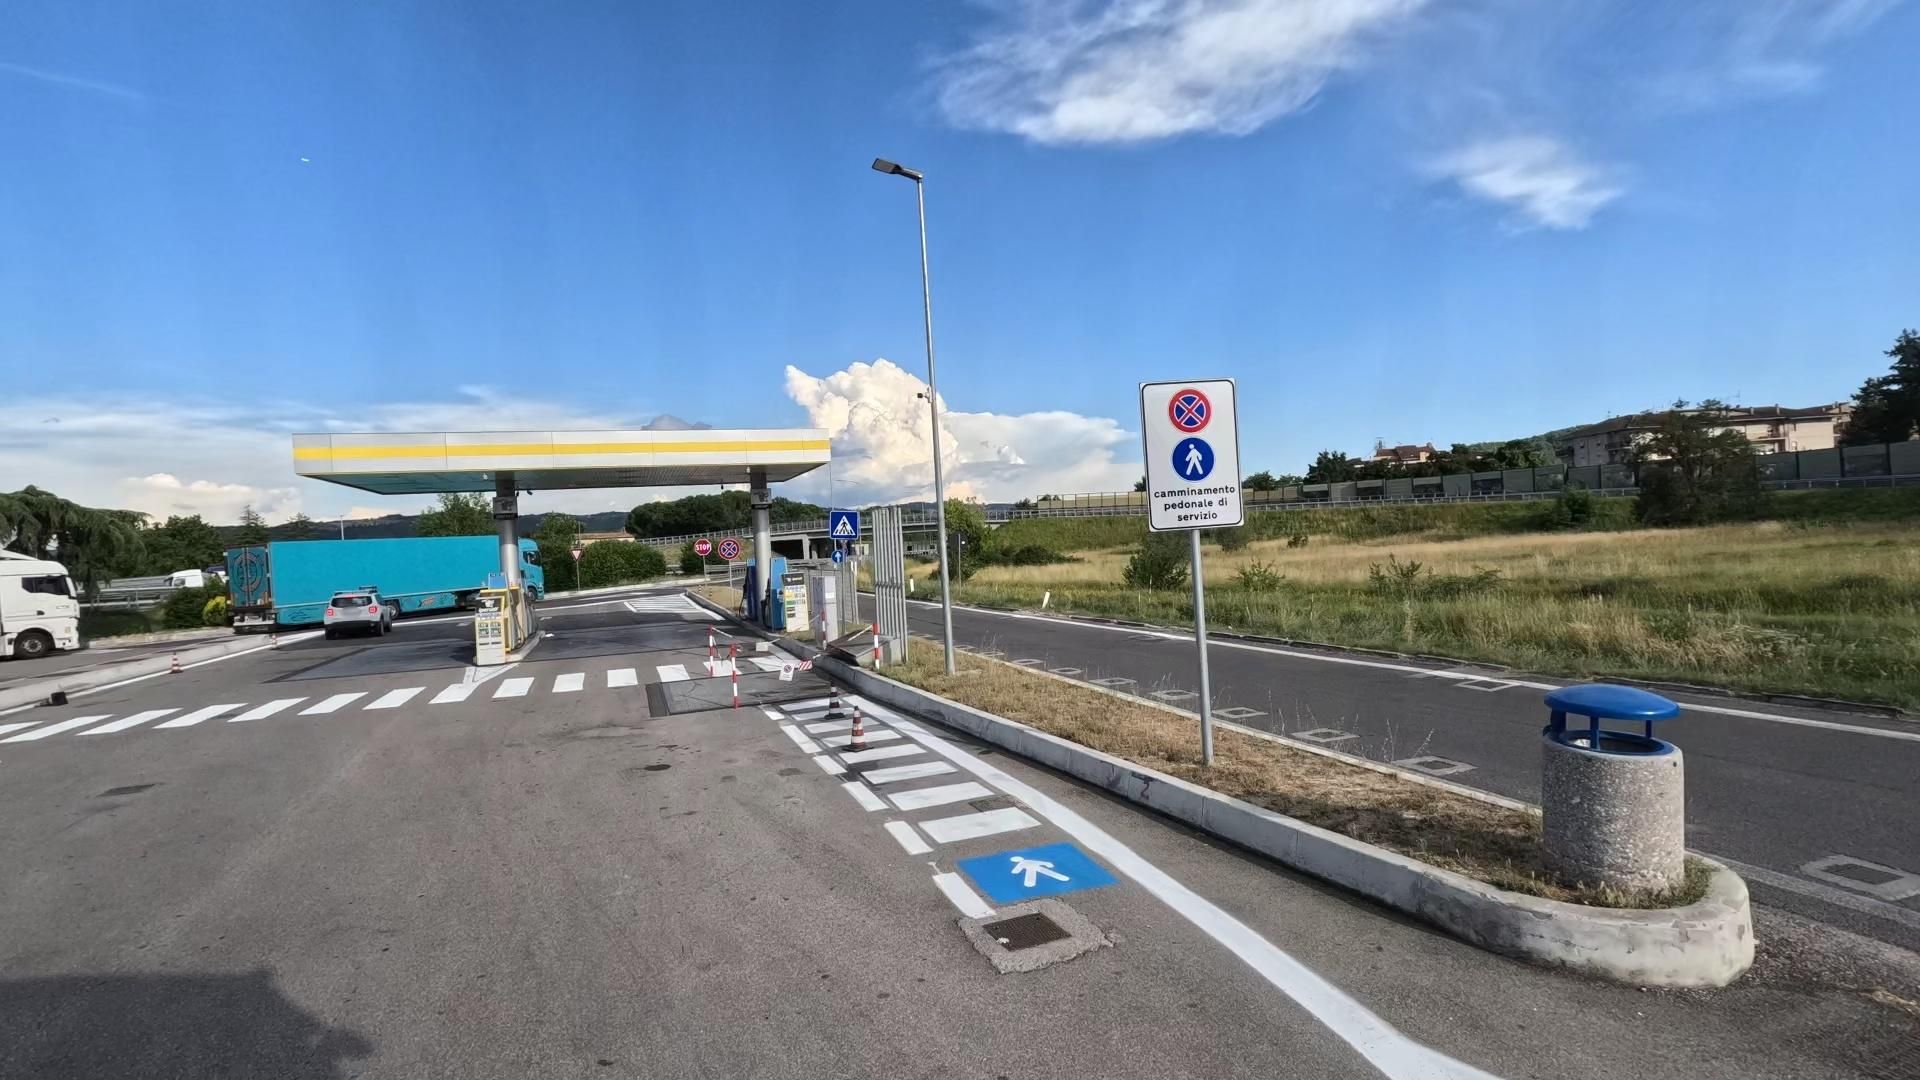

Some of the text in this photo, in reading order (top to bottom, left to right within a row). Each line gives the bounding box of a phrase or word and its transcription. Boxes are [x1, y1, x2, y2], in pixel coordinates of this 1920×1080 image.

[1154, 485, 1236, 498] camminamento
[1164, 498, 1228, 511] pedonale di
[1177, 511, 1217, 521] servizio
